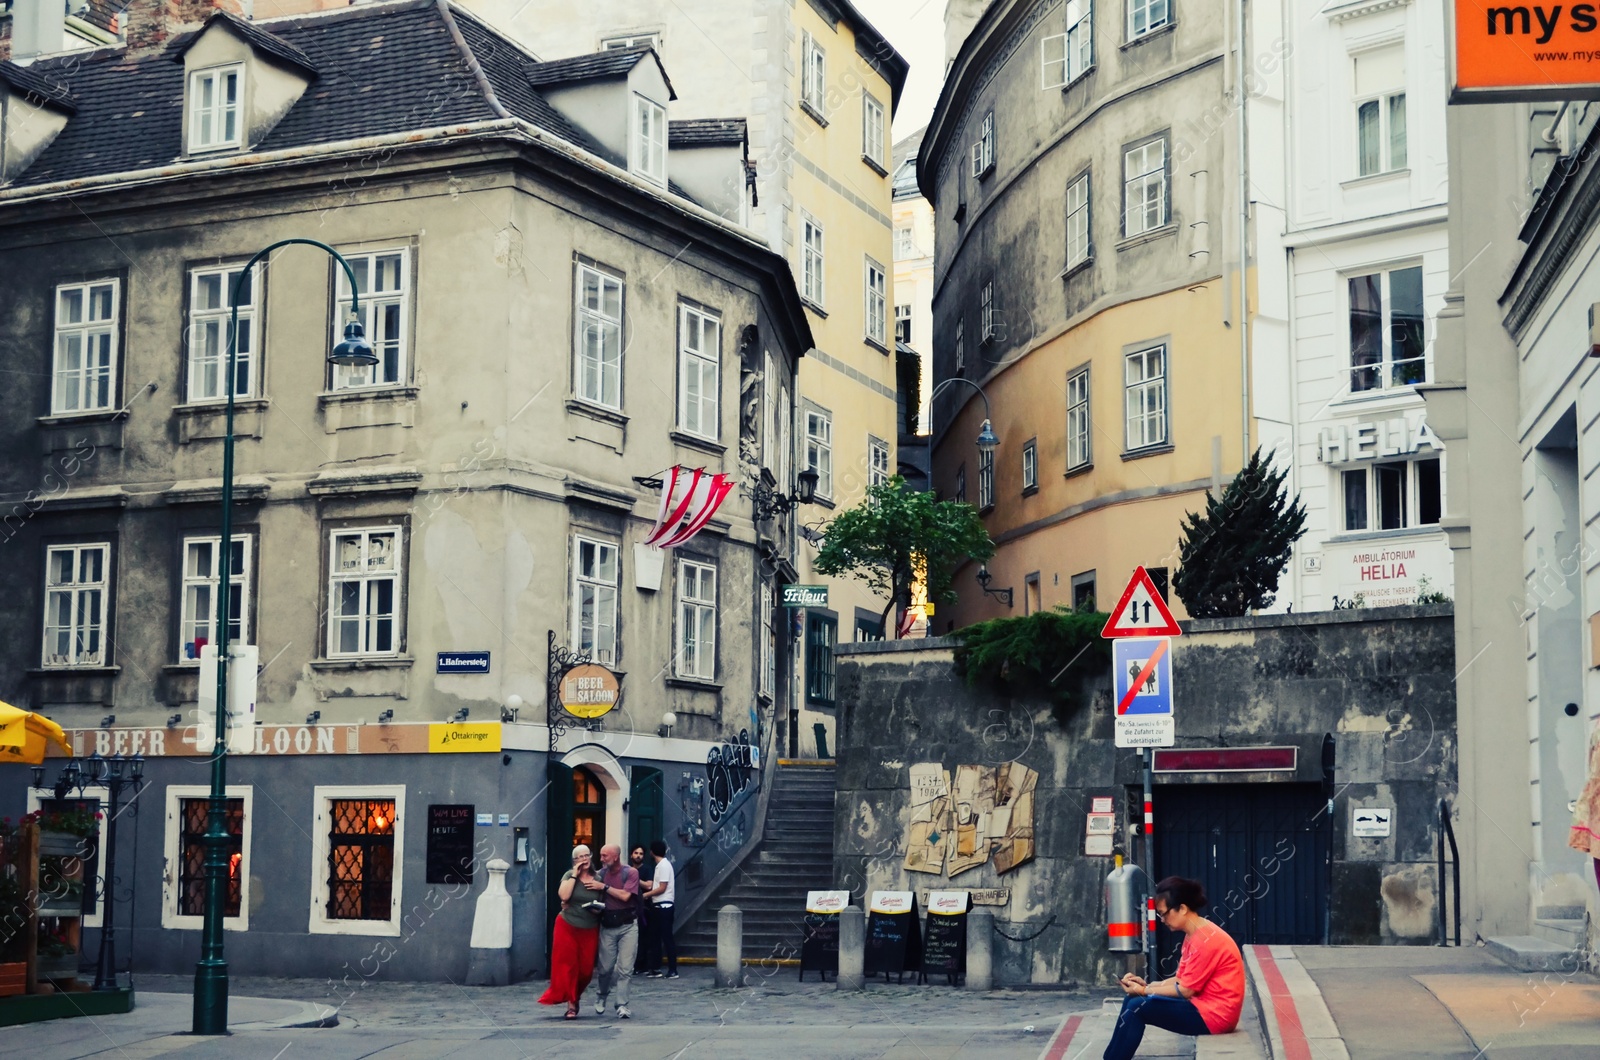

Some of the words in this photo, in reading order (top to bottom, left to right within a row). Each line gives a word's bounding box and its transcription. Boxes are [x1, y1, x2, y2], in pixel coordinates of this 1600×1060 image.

[1487, 4, 1600, 44] mys
[1319, 415, 1446, 463] HELIA
[1309, 558, 1315, 567] 8
[1352, 550, 1415, 564] AMBULATORIUM
[1361, 563, 1407, 582] HELIA
[1392, 586, 1416, 596] THERAPIE
[577, 677, 603, 689] BEER
[577, 690, 614, 702] SALOON
[95, 730, 166, 756] BEER
[252, 727, 335, 754] LOON
[451, 731, 489, 741] Ottakringer
[1126, 737, 1162, 745] Ladetätigkeit
[920, 788, 940, 798] 1984
[433, 808, 449, 817] WM
[450, 809, 469, 818] LIVE
[432, 826, 458, 834] HEUTE
